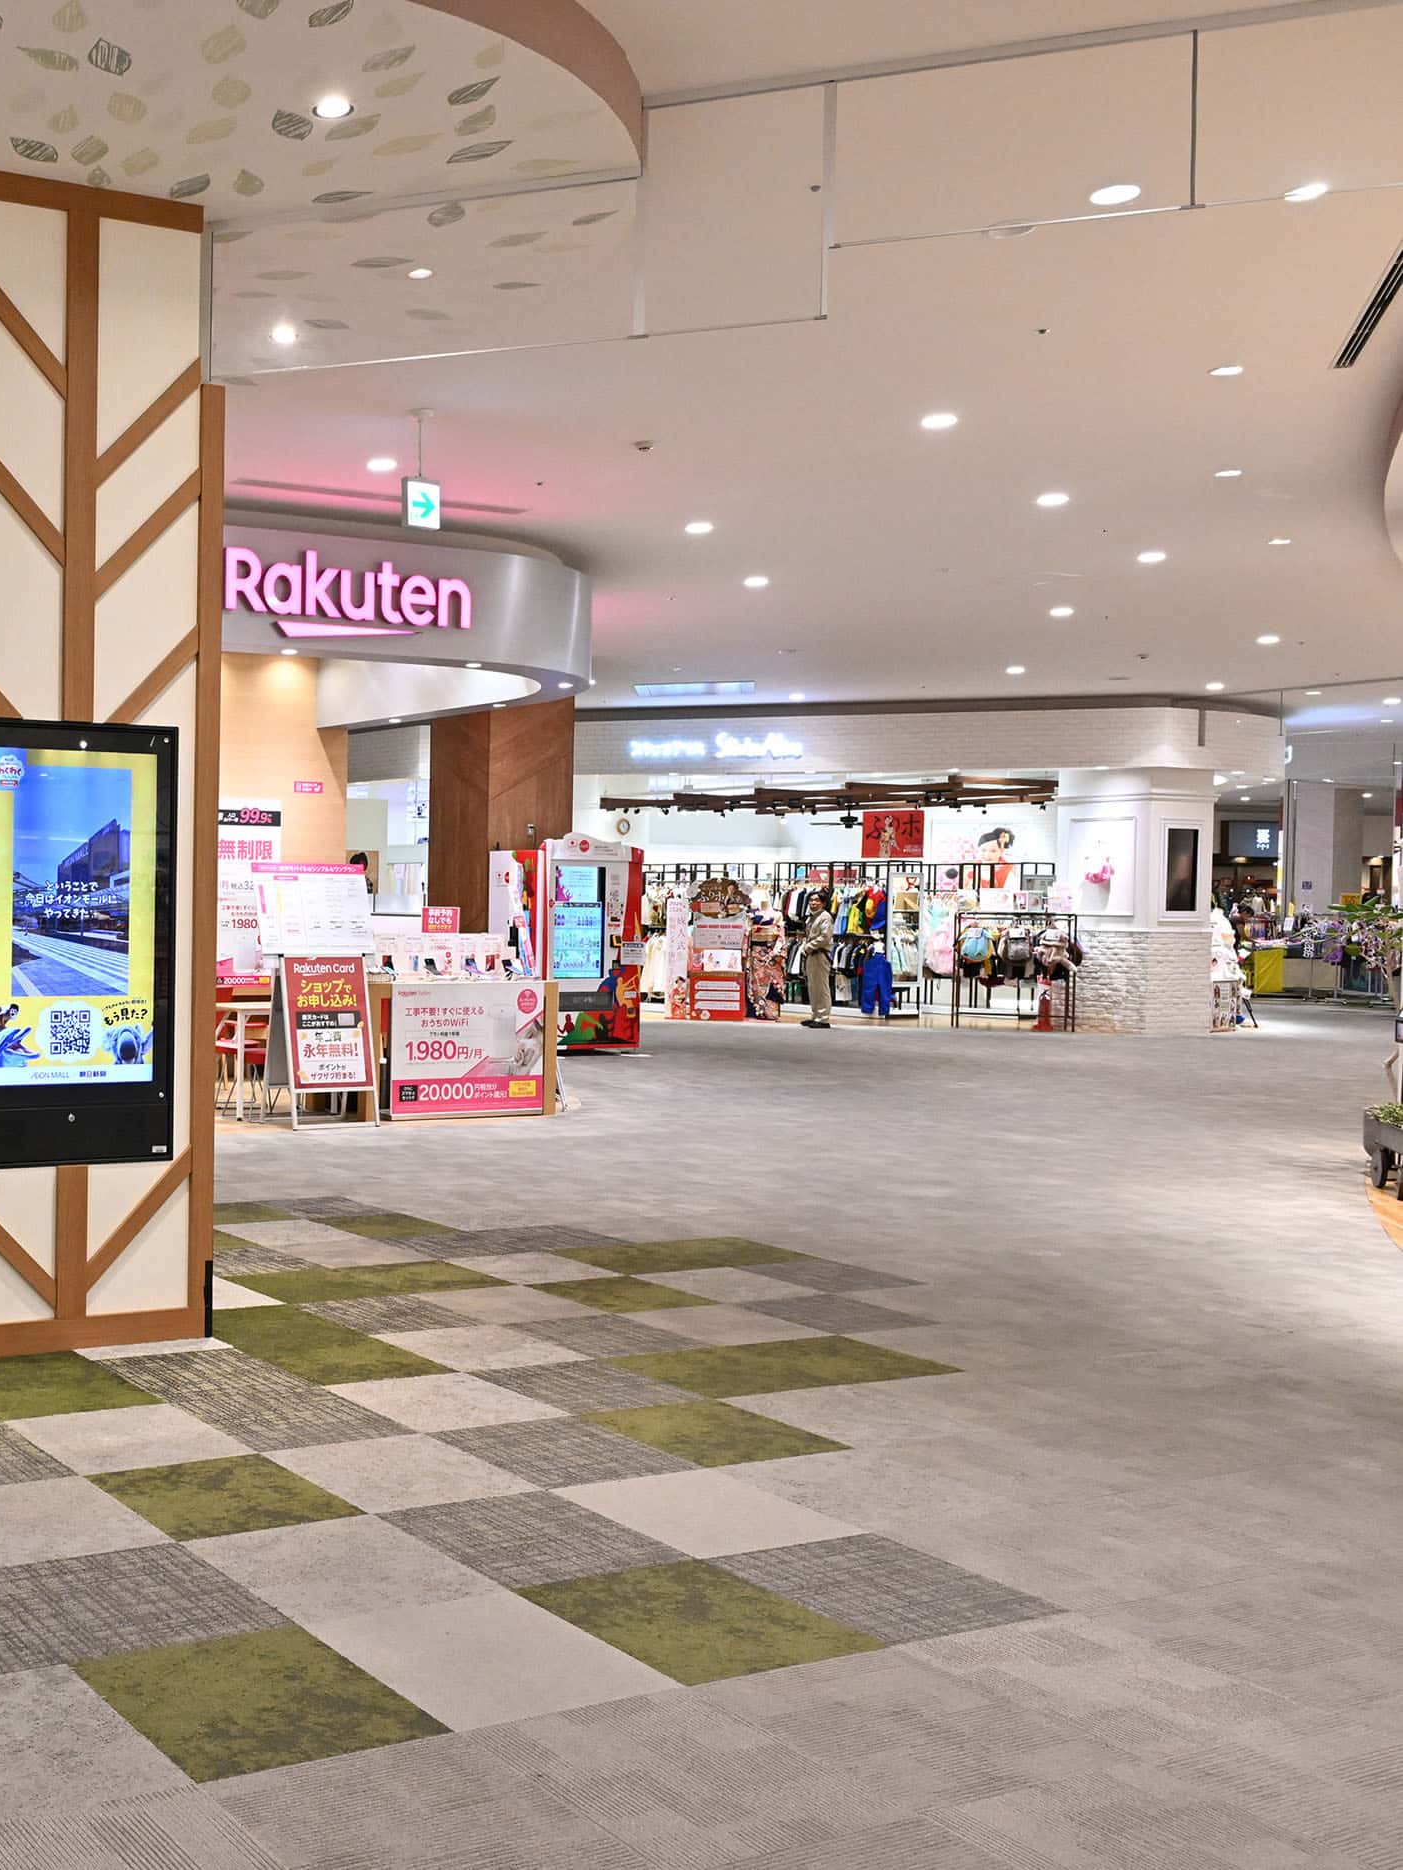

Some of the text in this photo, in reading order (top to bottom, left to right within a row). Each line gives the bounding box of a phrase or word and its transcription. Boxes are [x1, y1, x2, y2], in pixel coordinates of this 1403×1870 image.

[224, 546, 472, 630] Rakuten
[45, 880, 99, 891] ということで
[25, 893, 118, 905] 今日はイオンモールに
[293, 963, 355, 974] Rakuten Card
[300, 978, 352, 993] ショップで
[297, 994, 358, 1008] お申し込み!
[104, 1007, 149, 1026] もう見た?
[420, 1017, 469, 1028] おうちのWiFi
[302, 1043, 359, 1058] 永年無料!
